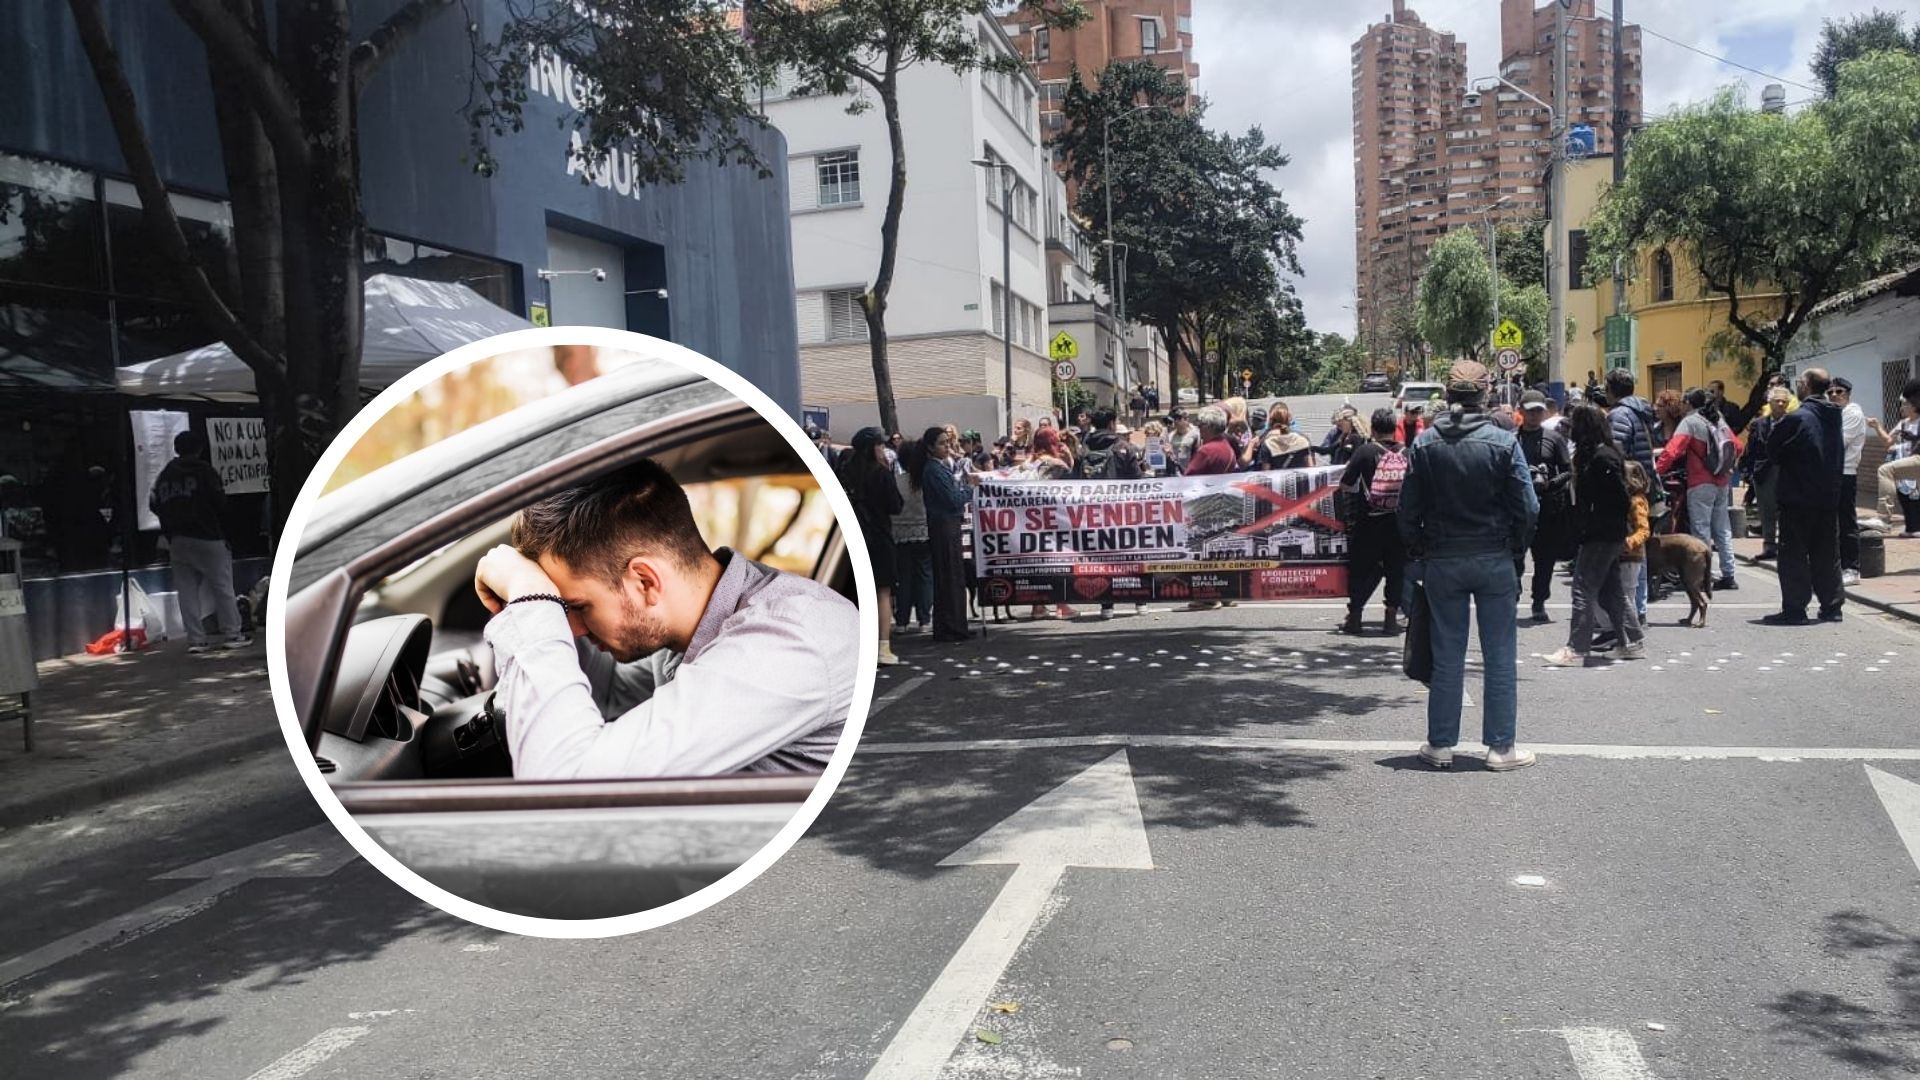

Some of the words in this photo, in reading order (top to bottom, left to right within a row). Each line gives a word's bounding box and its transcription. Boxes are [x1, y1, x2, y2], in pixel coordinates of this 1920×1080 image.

[1502, 354, 1516, 365] 30
[1058, 364, 1072, 376] 30
[214, 421, 232, 443] NO
[237, 422, 244, 440] A
[978, 484, 1073, 498] NUESTROS
[1080, 482, 1163, 496] BARRIOS
[978, 498, 993, 508] LA
[995, 496, 1058, 508] MACARENA
[979, 509, 1016, 533] NO
[1025, 507, 1059, 531] SE
[1066, 500, 1192, 529] VENDEN.
[982, 533, 1009, 556] SE
[1019, 524, 1184, 553] DEFIENDEN.
[1078, 564, 1106, 573] CLICK
[1108, 562, 1140, 572] LIVING
